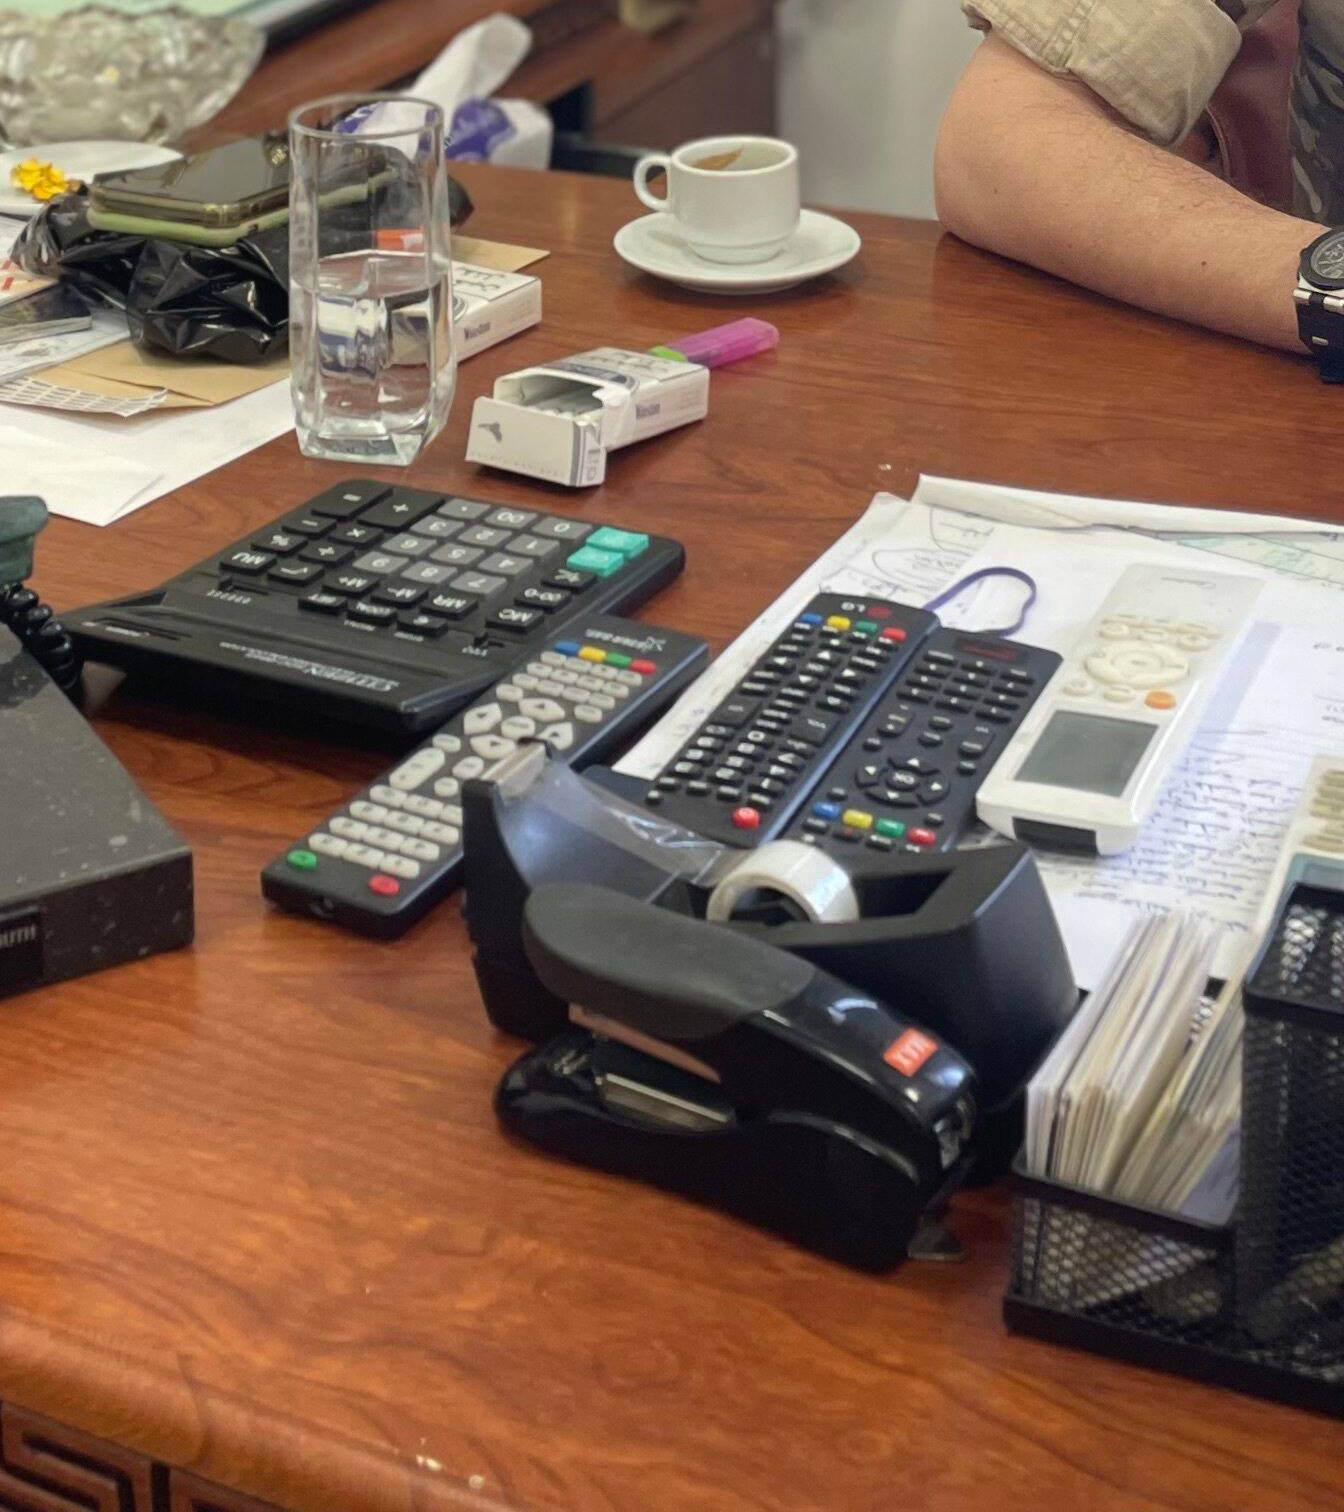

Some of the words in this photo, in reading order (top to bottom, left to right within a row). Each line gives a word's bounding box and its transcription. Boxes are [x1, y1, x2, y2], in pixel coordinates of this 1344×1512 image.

[232, 551, 266, 566] MU
[432, 594, 468, 609] MR
[841, 601, 866, 613] LG
[498, 608, 534, 624] MC
